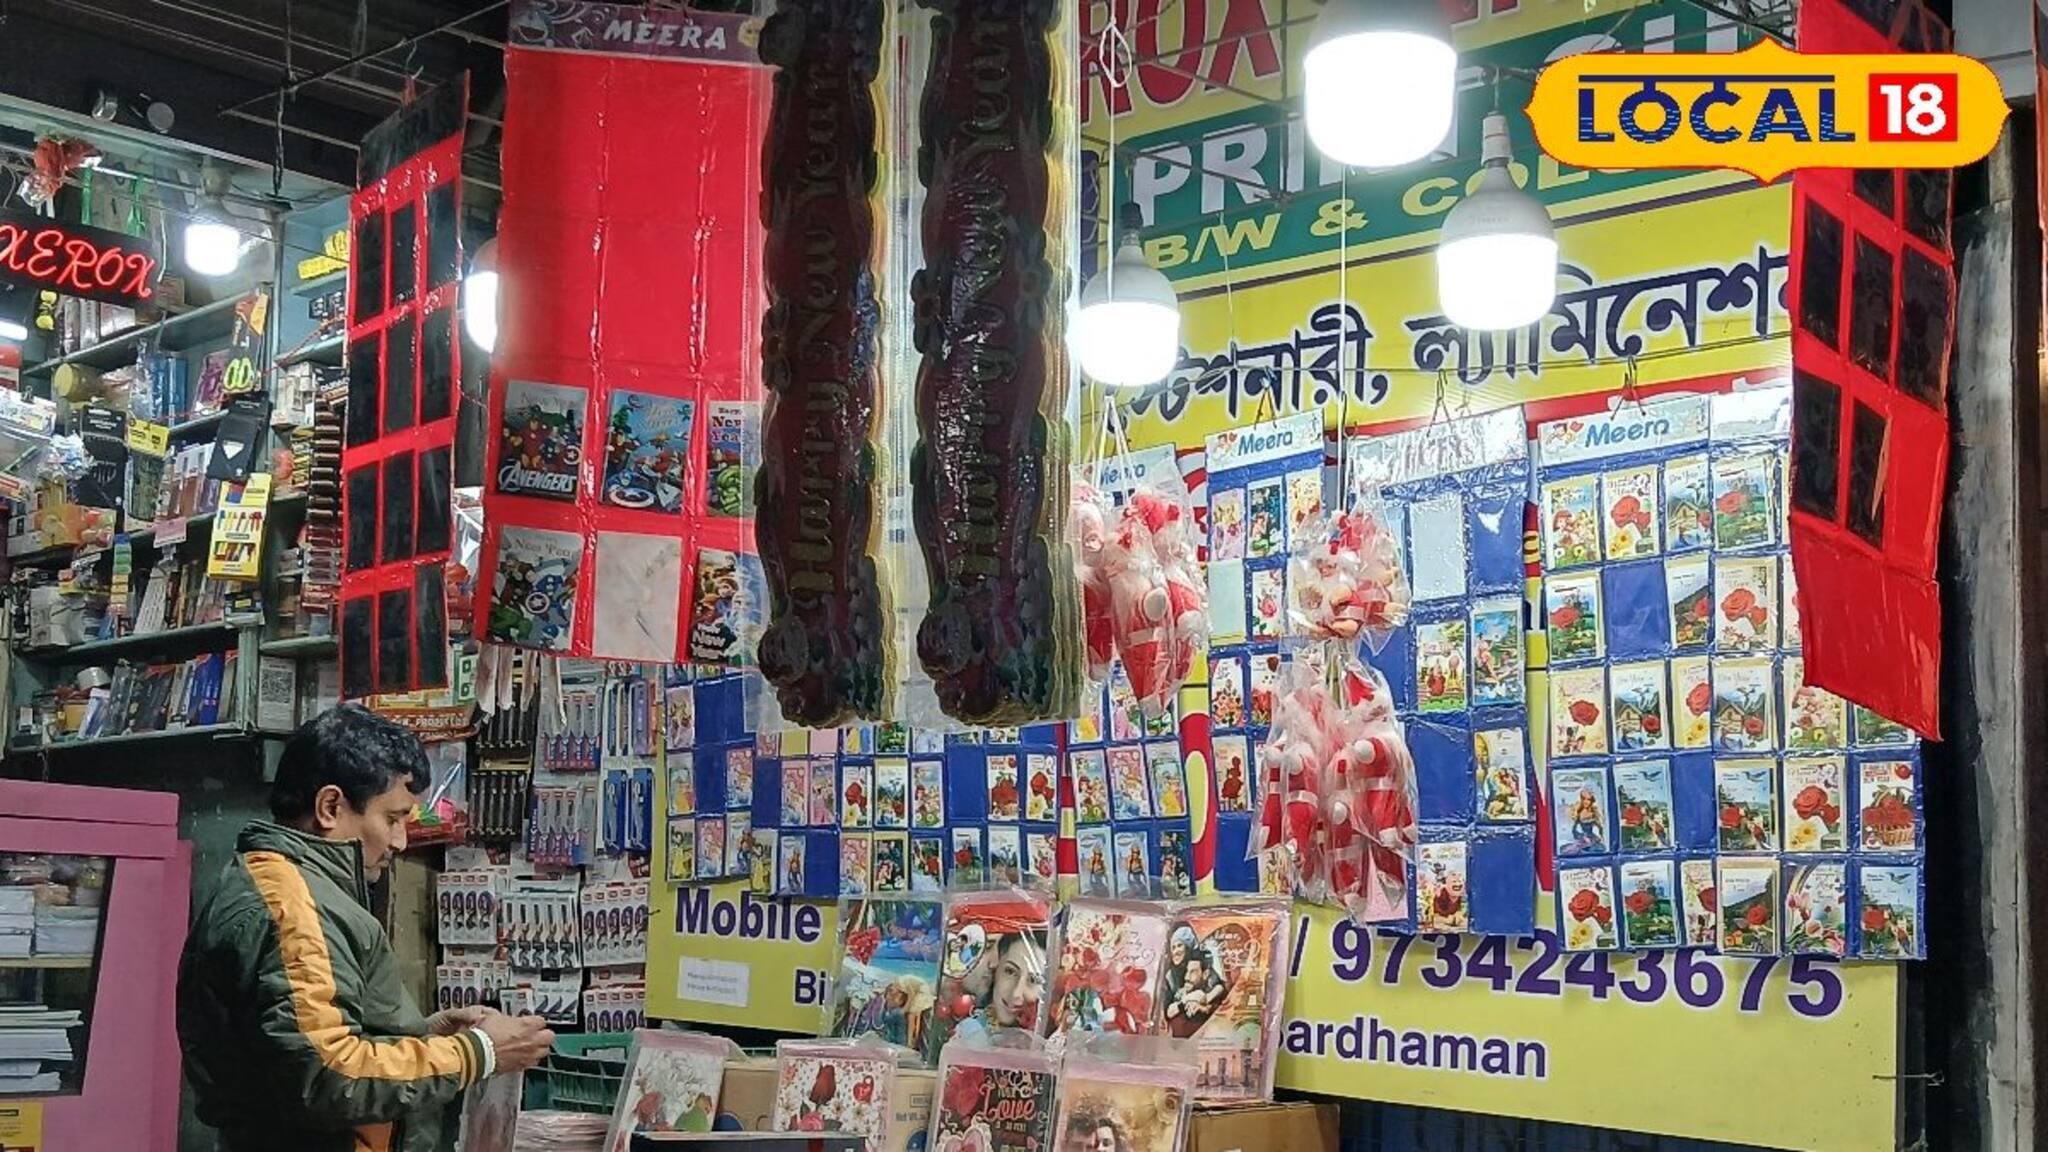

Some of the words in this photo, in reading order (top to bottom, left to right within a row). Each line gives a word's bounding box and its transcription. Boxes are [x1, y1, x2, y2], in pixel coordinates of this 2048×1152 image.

[603, 19, 726, 50] MEERA
[0, 225, 155, 298] XEROX
[1145, 213, 1281, 270] B/W
[1310, 199, 1368, 238] &
[796, 227, 840, 348] New
[1239, 430, 1293, 457] Meera
[1585, 416, 1669, 449] Meera
[498, 460, 578, 492] AVENGERS
[791, 380, 850, 593] Happy
[676, 886, 821, 943] Mobile
[1332, 919, 1843, 1017] 9734243675
[1279, 1016, 1546, 1078] ardhaman
